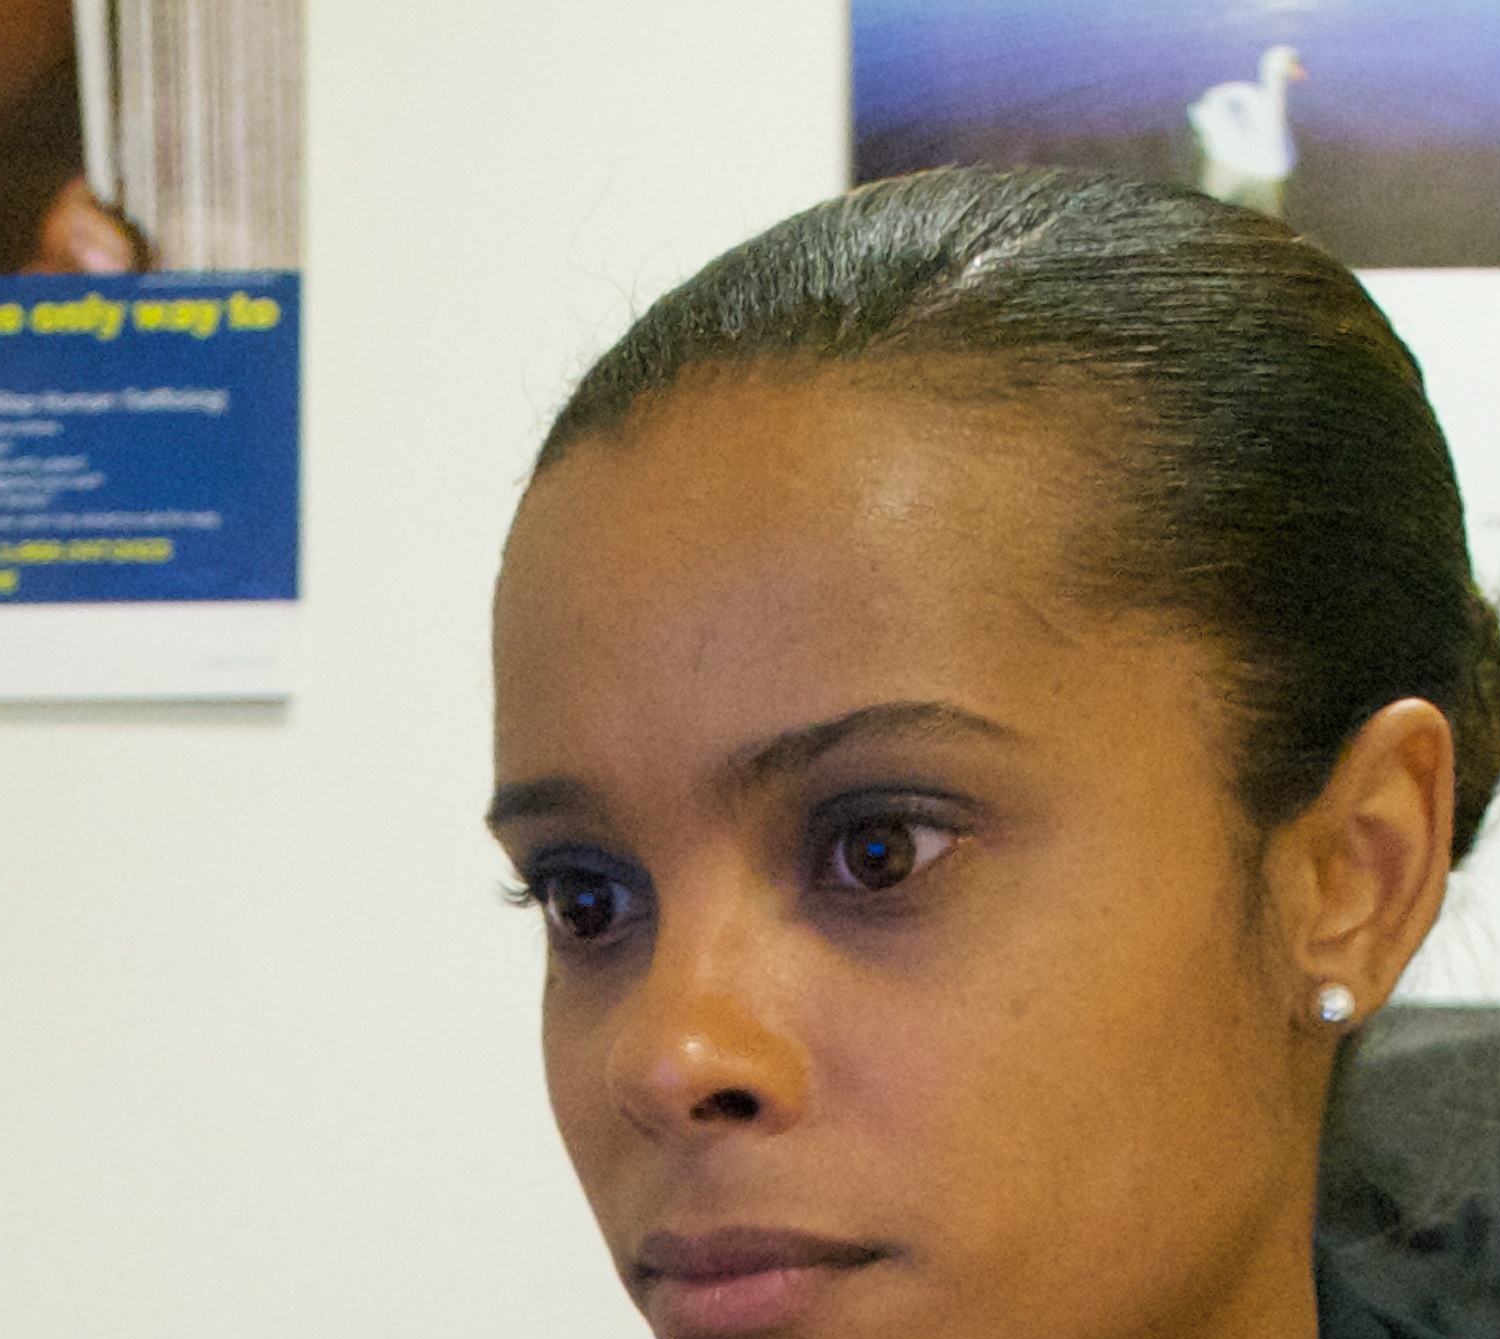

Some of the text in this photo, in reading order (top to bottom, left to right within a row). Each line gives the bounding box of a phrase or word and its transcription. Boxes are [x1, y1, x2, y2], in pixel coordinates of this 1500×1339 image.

[30, 292, 125, 340] only
[133, 299, 221, 340] way
[227, 291, 281, 331] to
